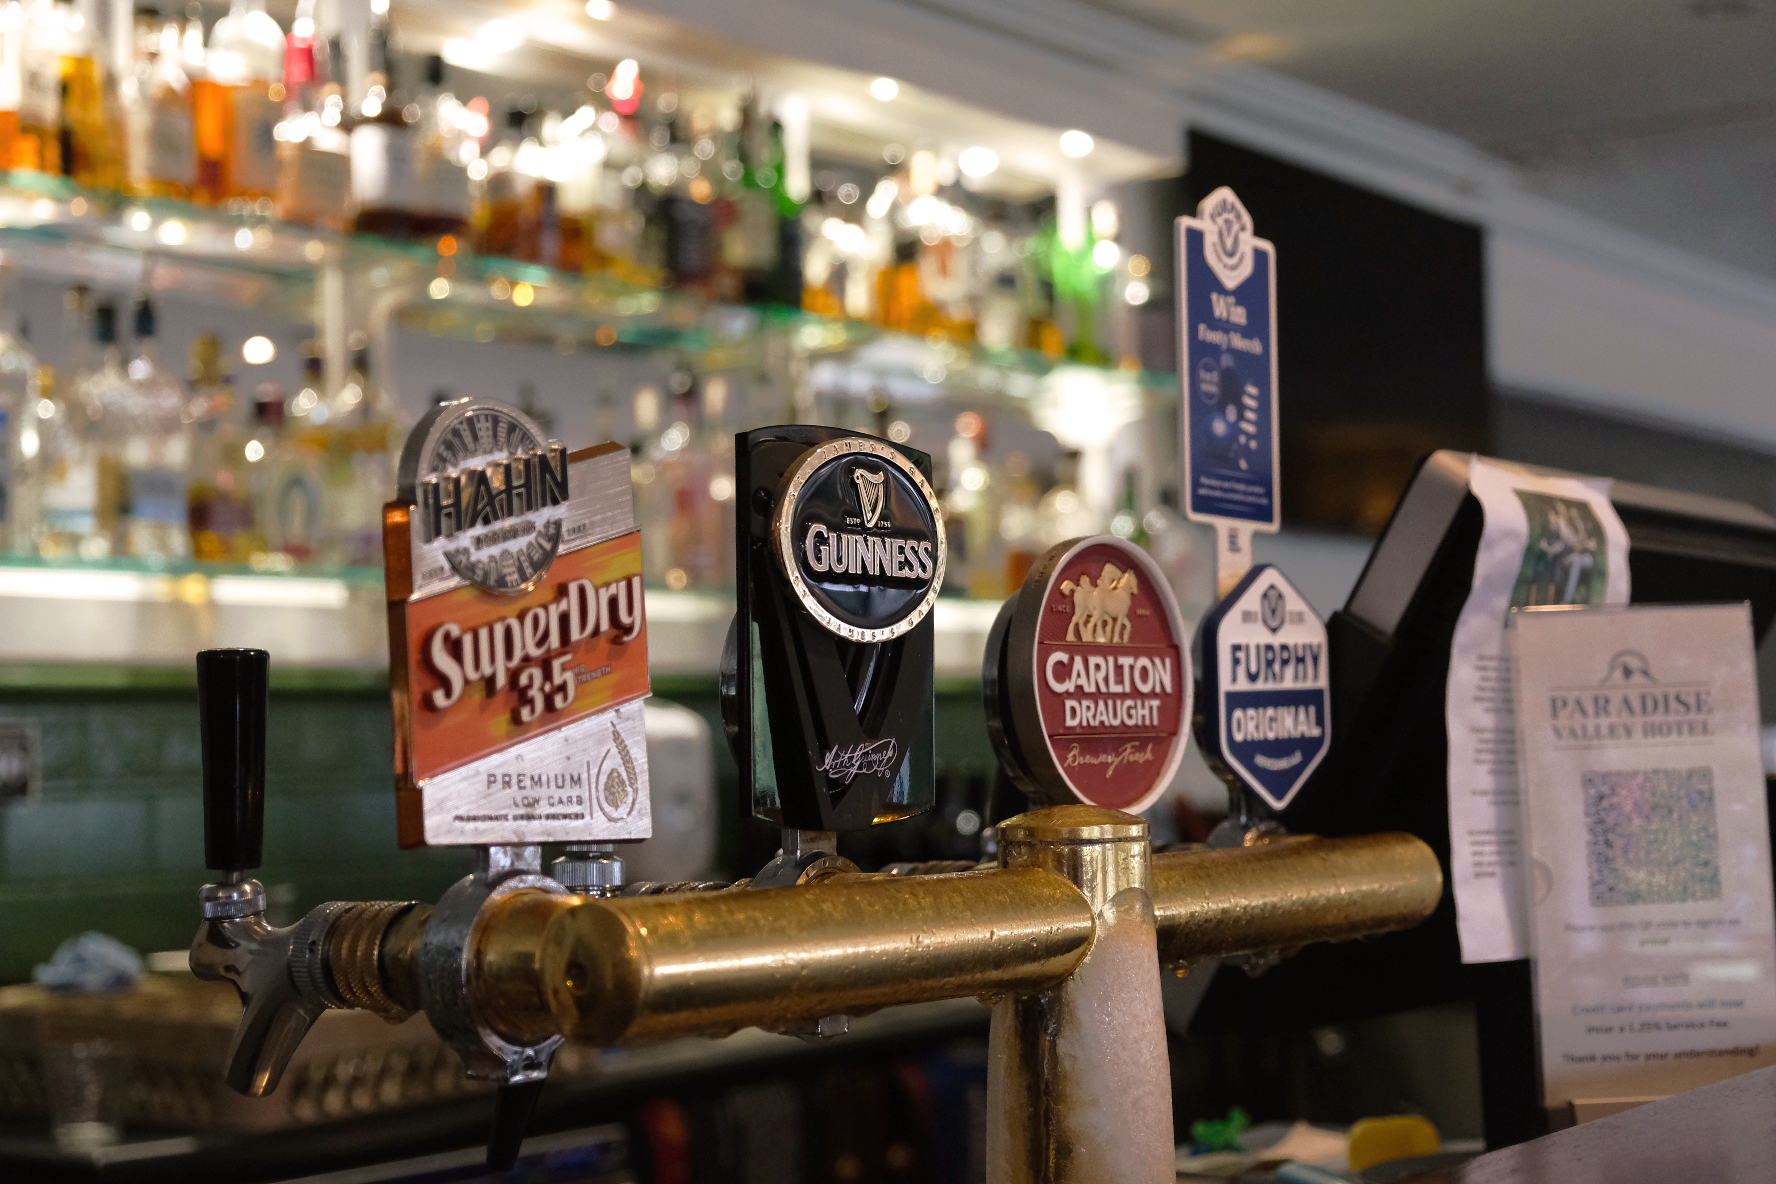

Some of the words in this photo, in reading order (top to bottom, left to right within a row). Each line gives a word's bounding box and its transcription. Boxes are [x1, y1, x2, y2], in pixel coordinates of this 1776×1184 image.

[422, 447, 569, 544] HAHN
[806, 524, 933, 579] GUINNESS
[428, 575, 643, 709] SuperDry
[1046, 651, 1174, 694] CARLTON
[1230, 643, 1321, 684] FURPHY
[1065, 699, 1161, 728] DRAUGHT
[1231, 704, 1322, 743] ORIGINAL
[1551, 690, 1713, 720] PARADISE
[1552, 721, 1633, 742] VALLEY
[1641, 719, 1713, 741] HOTEL
[486, 772, 583, 790] PREMIUM
[512, 795, 541, 808] LOW
[547, 795, 584, 807] CARB
